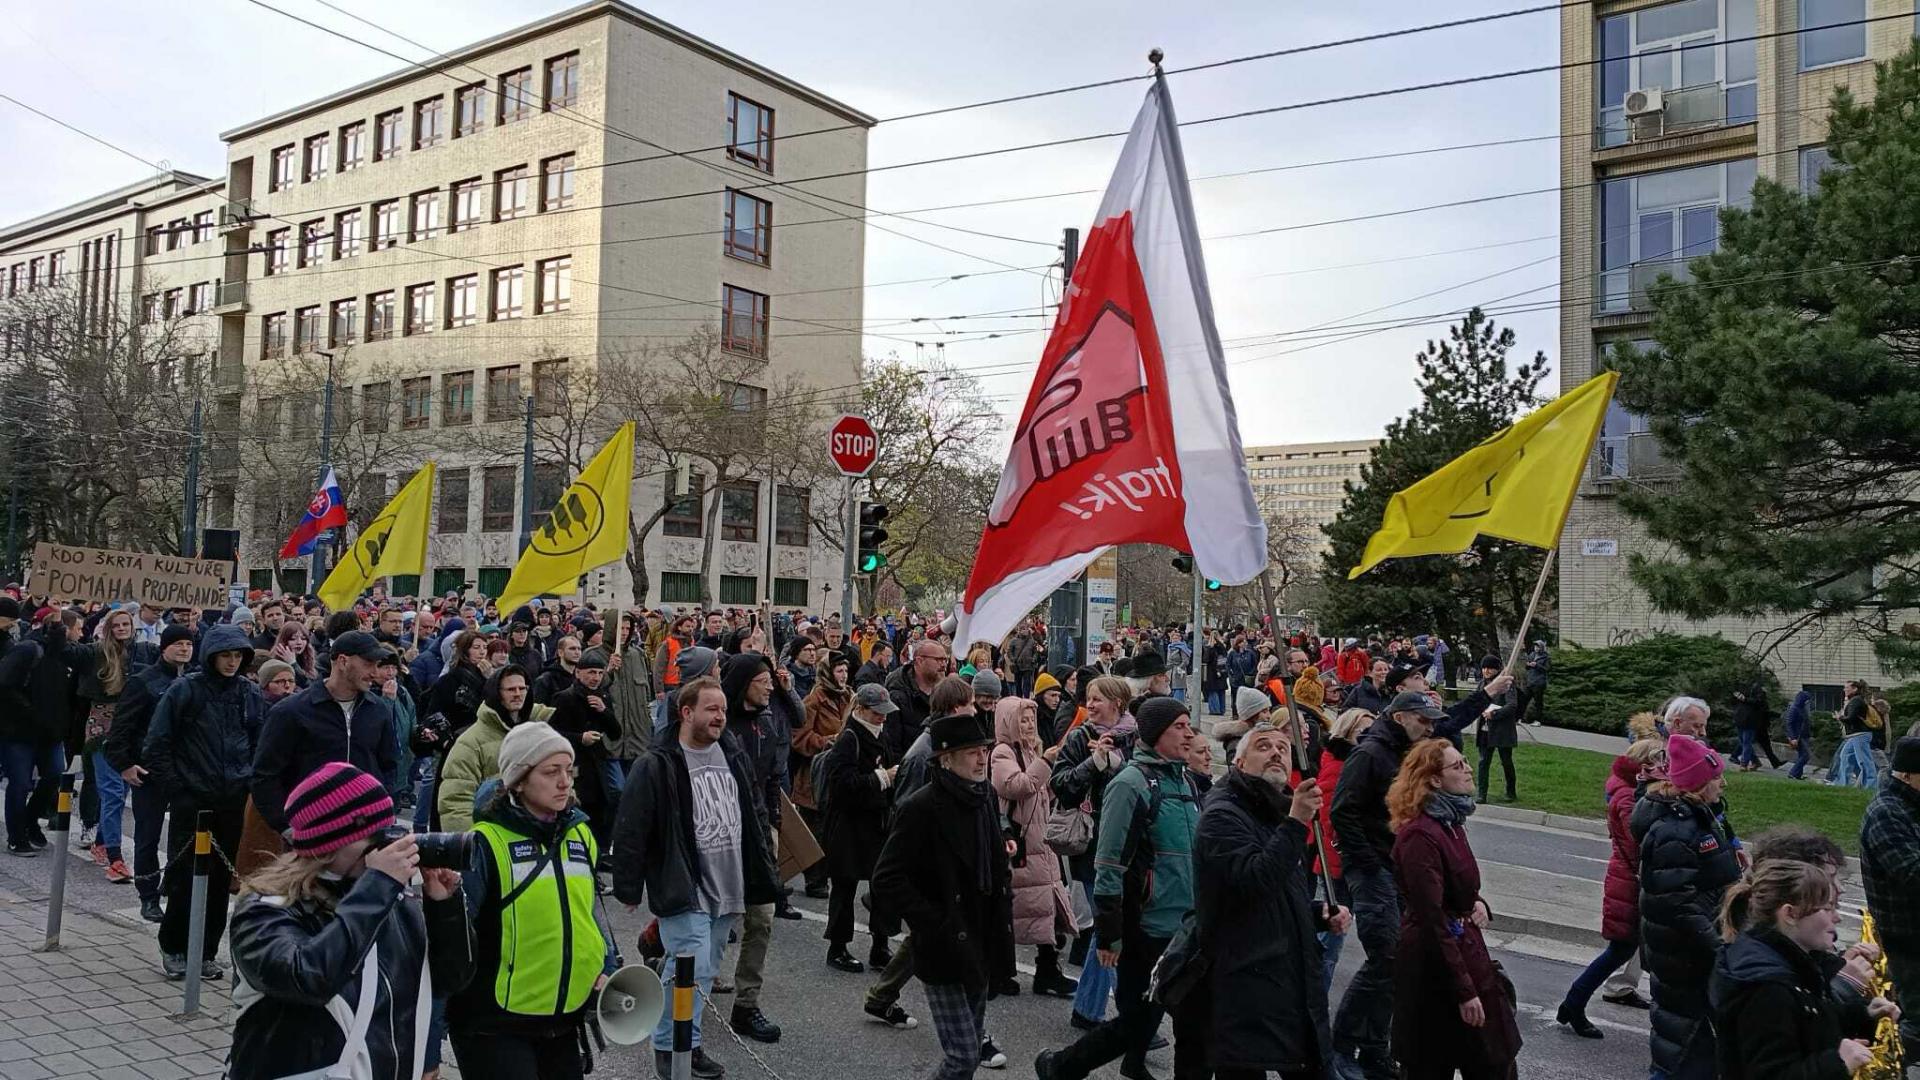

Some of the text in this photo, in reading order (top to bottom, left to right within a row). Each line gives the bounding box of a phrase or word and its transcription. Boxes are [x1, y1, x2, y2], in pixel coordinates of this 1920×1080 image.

[834, 432, 874, 457] STOP
[50, 547, 85, 564] KDO
[95, 551, 144, 571] ŠKRTÁ
[49, 569, 134, 600] POMÁHA
